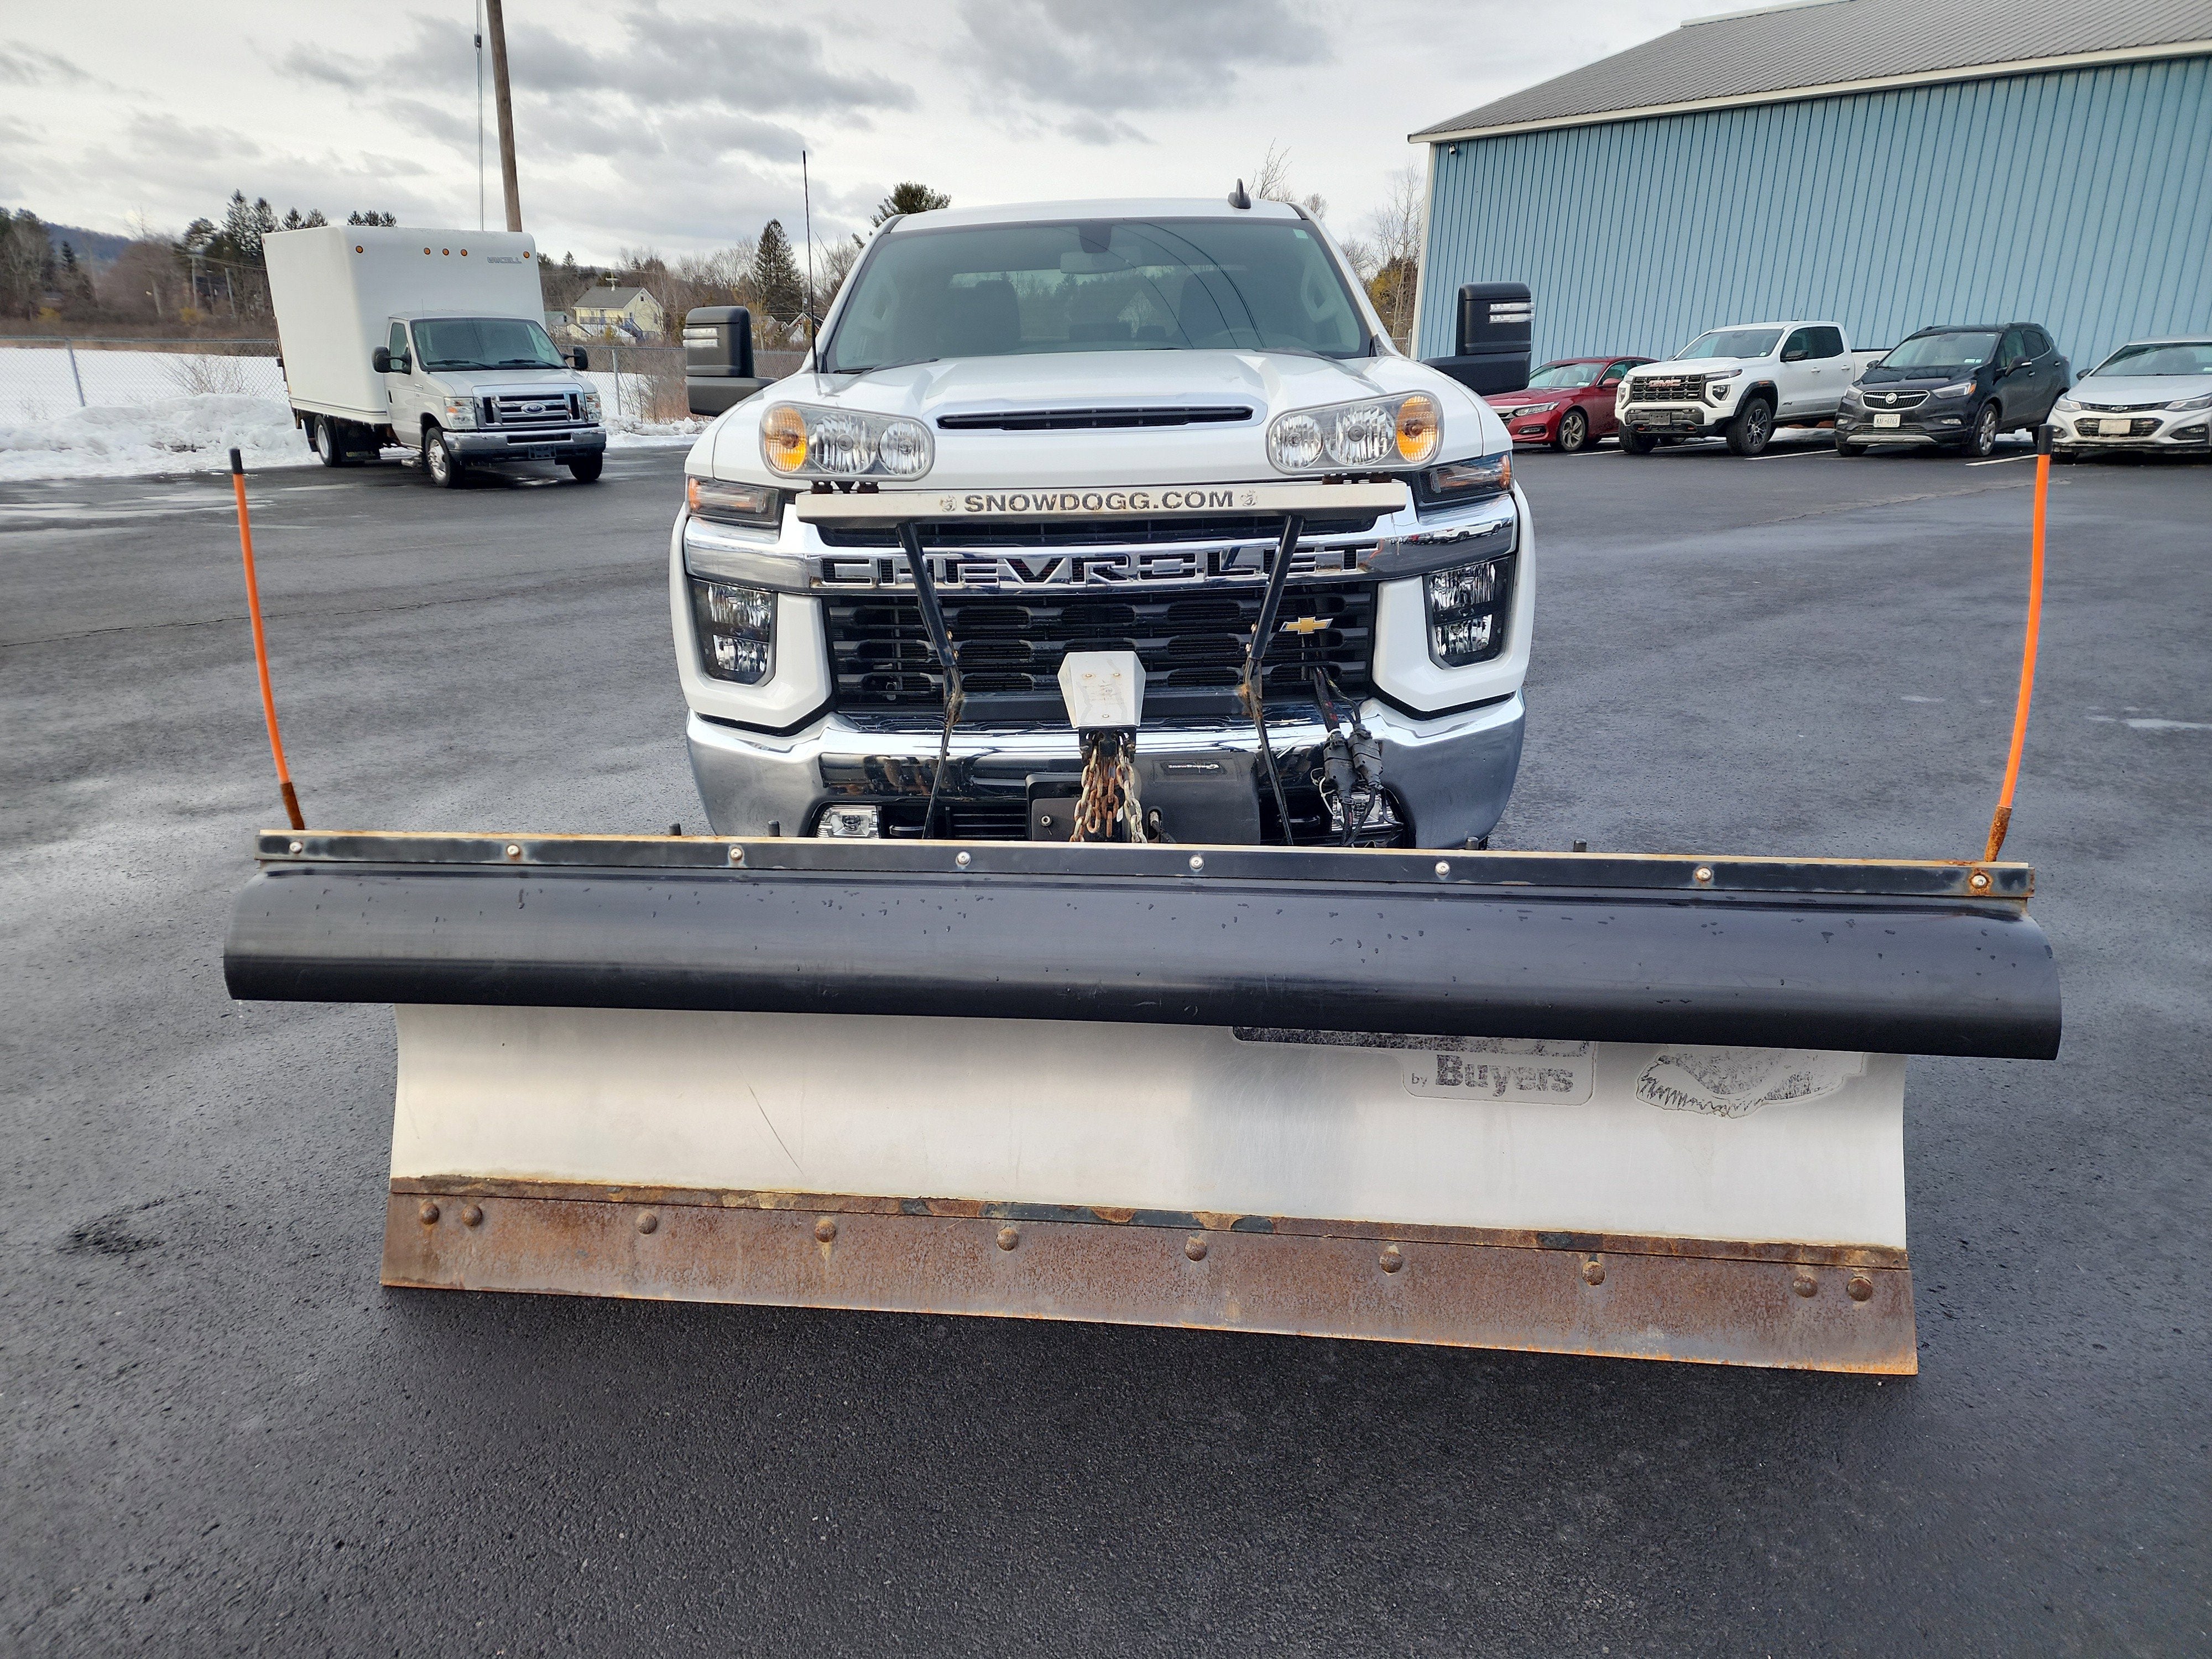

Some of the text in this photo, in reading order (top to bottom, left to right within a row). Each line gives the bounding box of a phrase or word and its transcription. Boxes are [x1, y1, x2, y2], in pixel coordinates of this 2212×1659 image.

[964, 490, 1234, 512] SNOWDOGG.COM
[821, 543, 1378, 586] CHEVROLET
[1411, 1054, 1573, 1097] by Buyers
